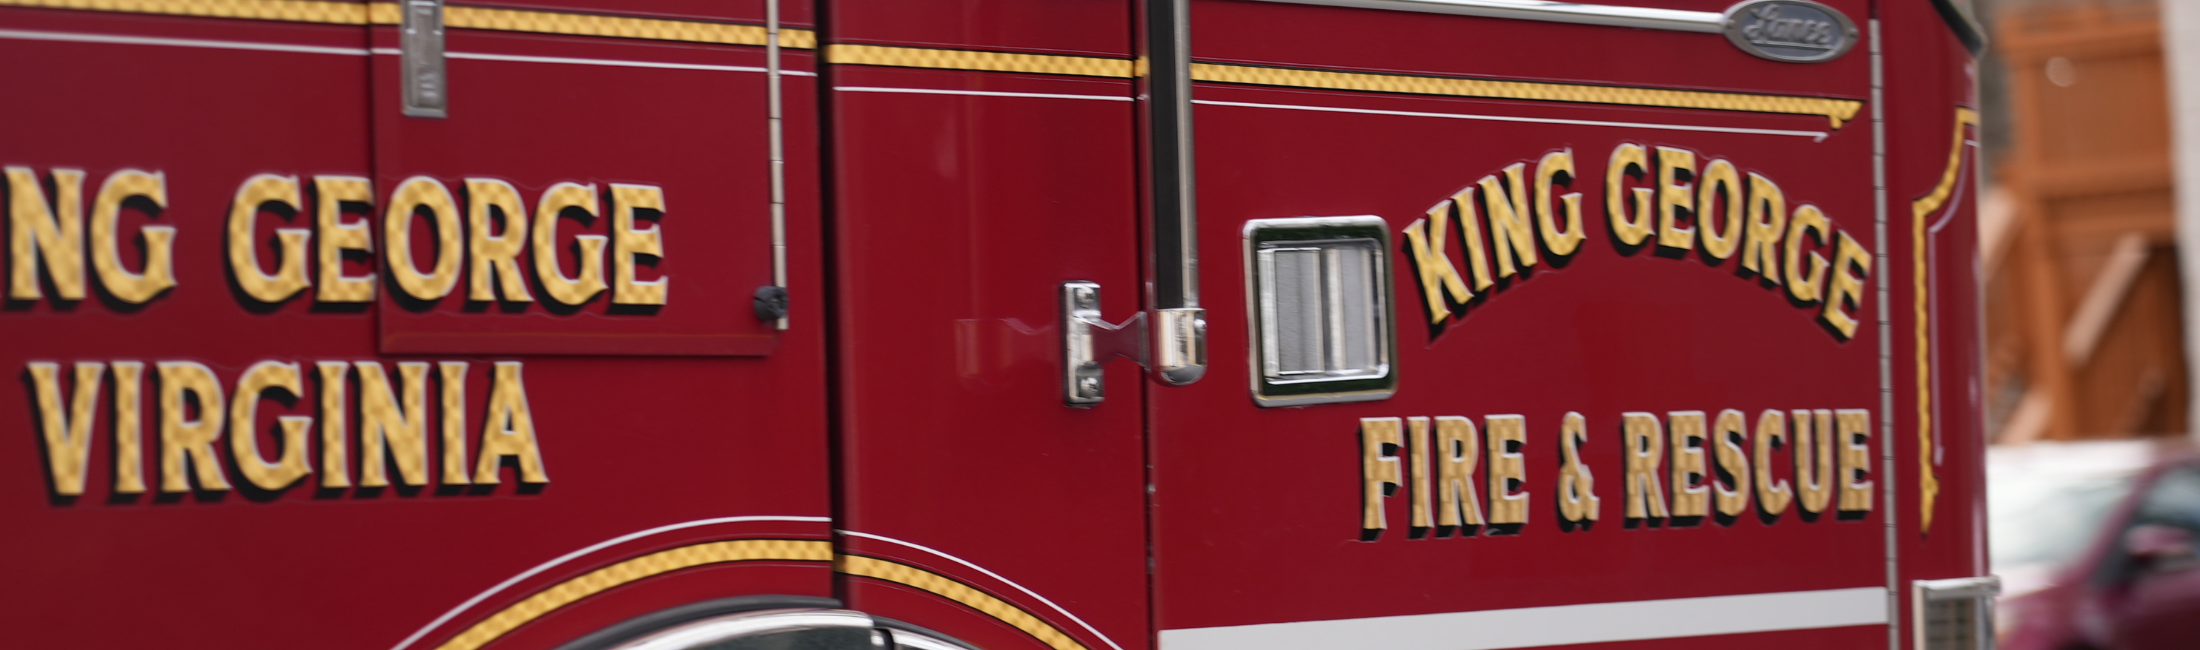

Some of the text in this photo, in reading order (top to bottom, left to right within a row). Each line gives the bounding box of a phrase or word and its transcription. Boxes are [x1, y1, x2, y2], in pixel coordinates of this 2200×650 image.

[224, 172, 669, 315] GEORGE
[1402, 142, 1873, 342] KING GEORGE
[25, 360, 550, 505] VIRGINIA
[1359, 408, 1874, 542] FIRE & RESCUE
